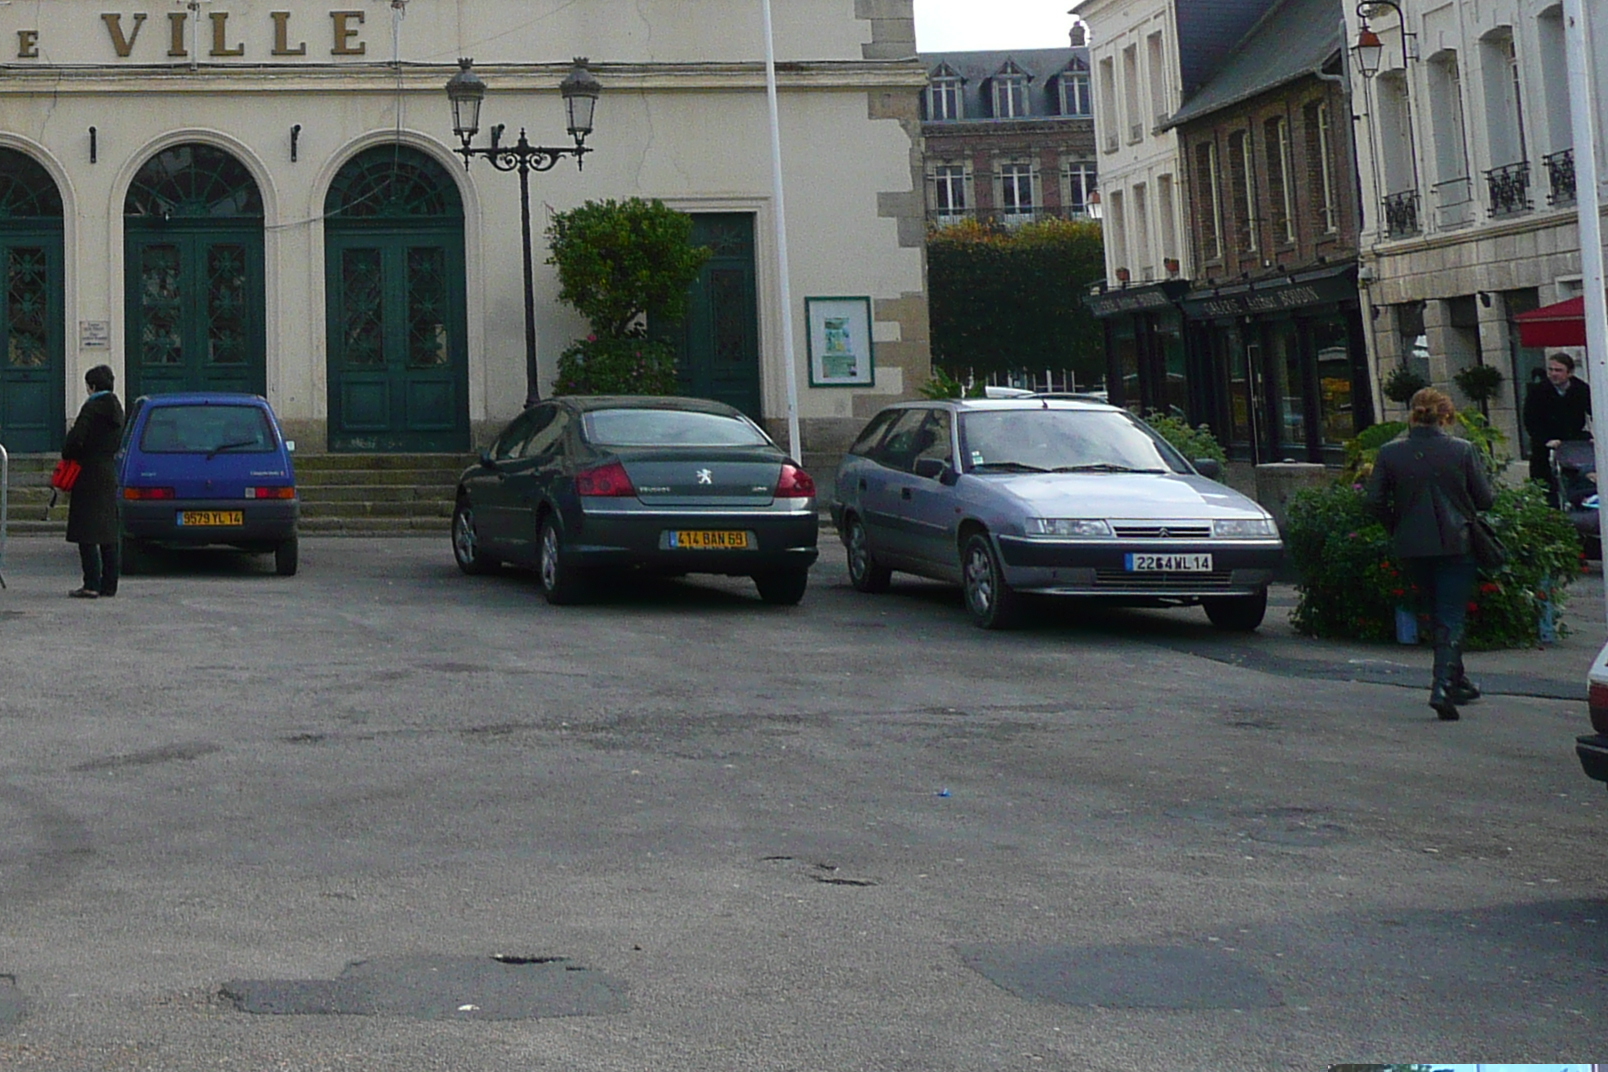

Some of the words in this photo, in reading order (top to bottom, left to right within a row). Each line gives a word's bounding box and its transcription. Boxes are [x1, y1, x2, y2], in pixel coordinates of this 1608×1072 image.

[100, 10, 366, 58] VILLE
[183, 512, 211, 525] 9579
[678, 532, 700, 545] 414
